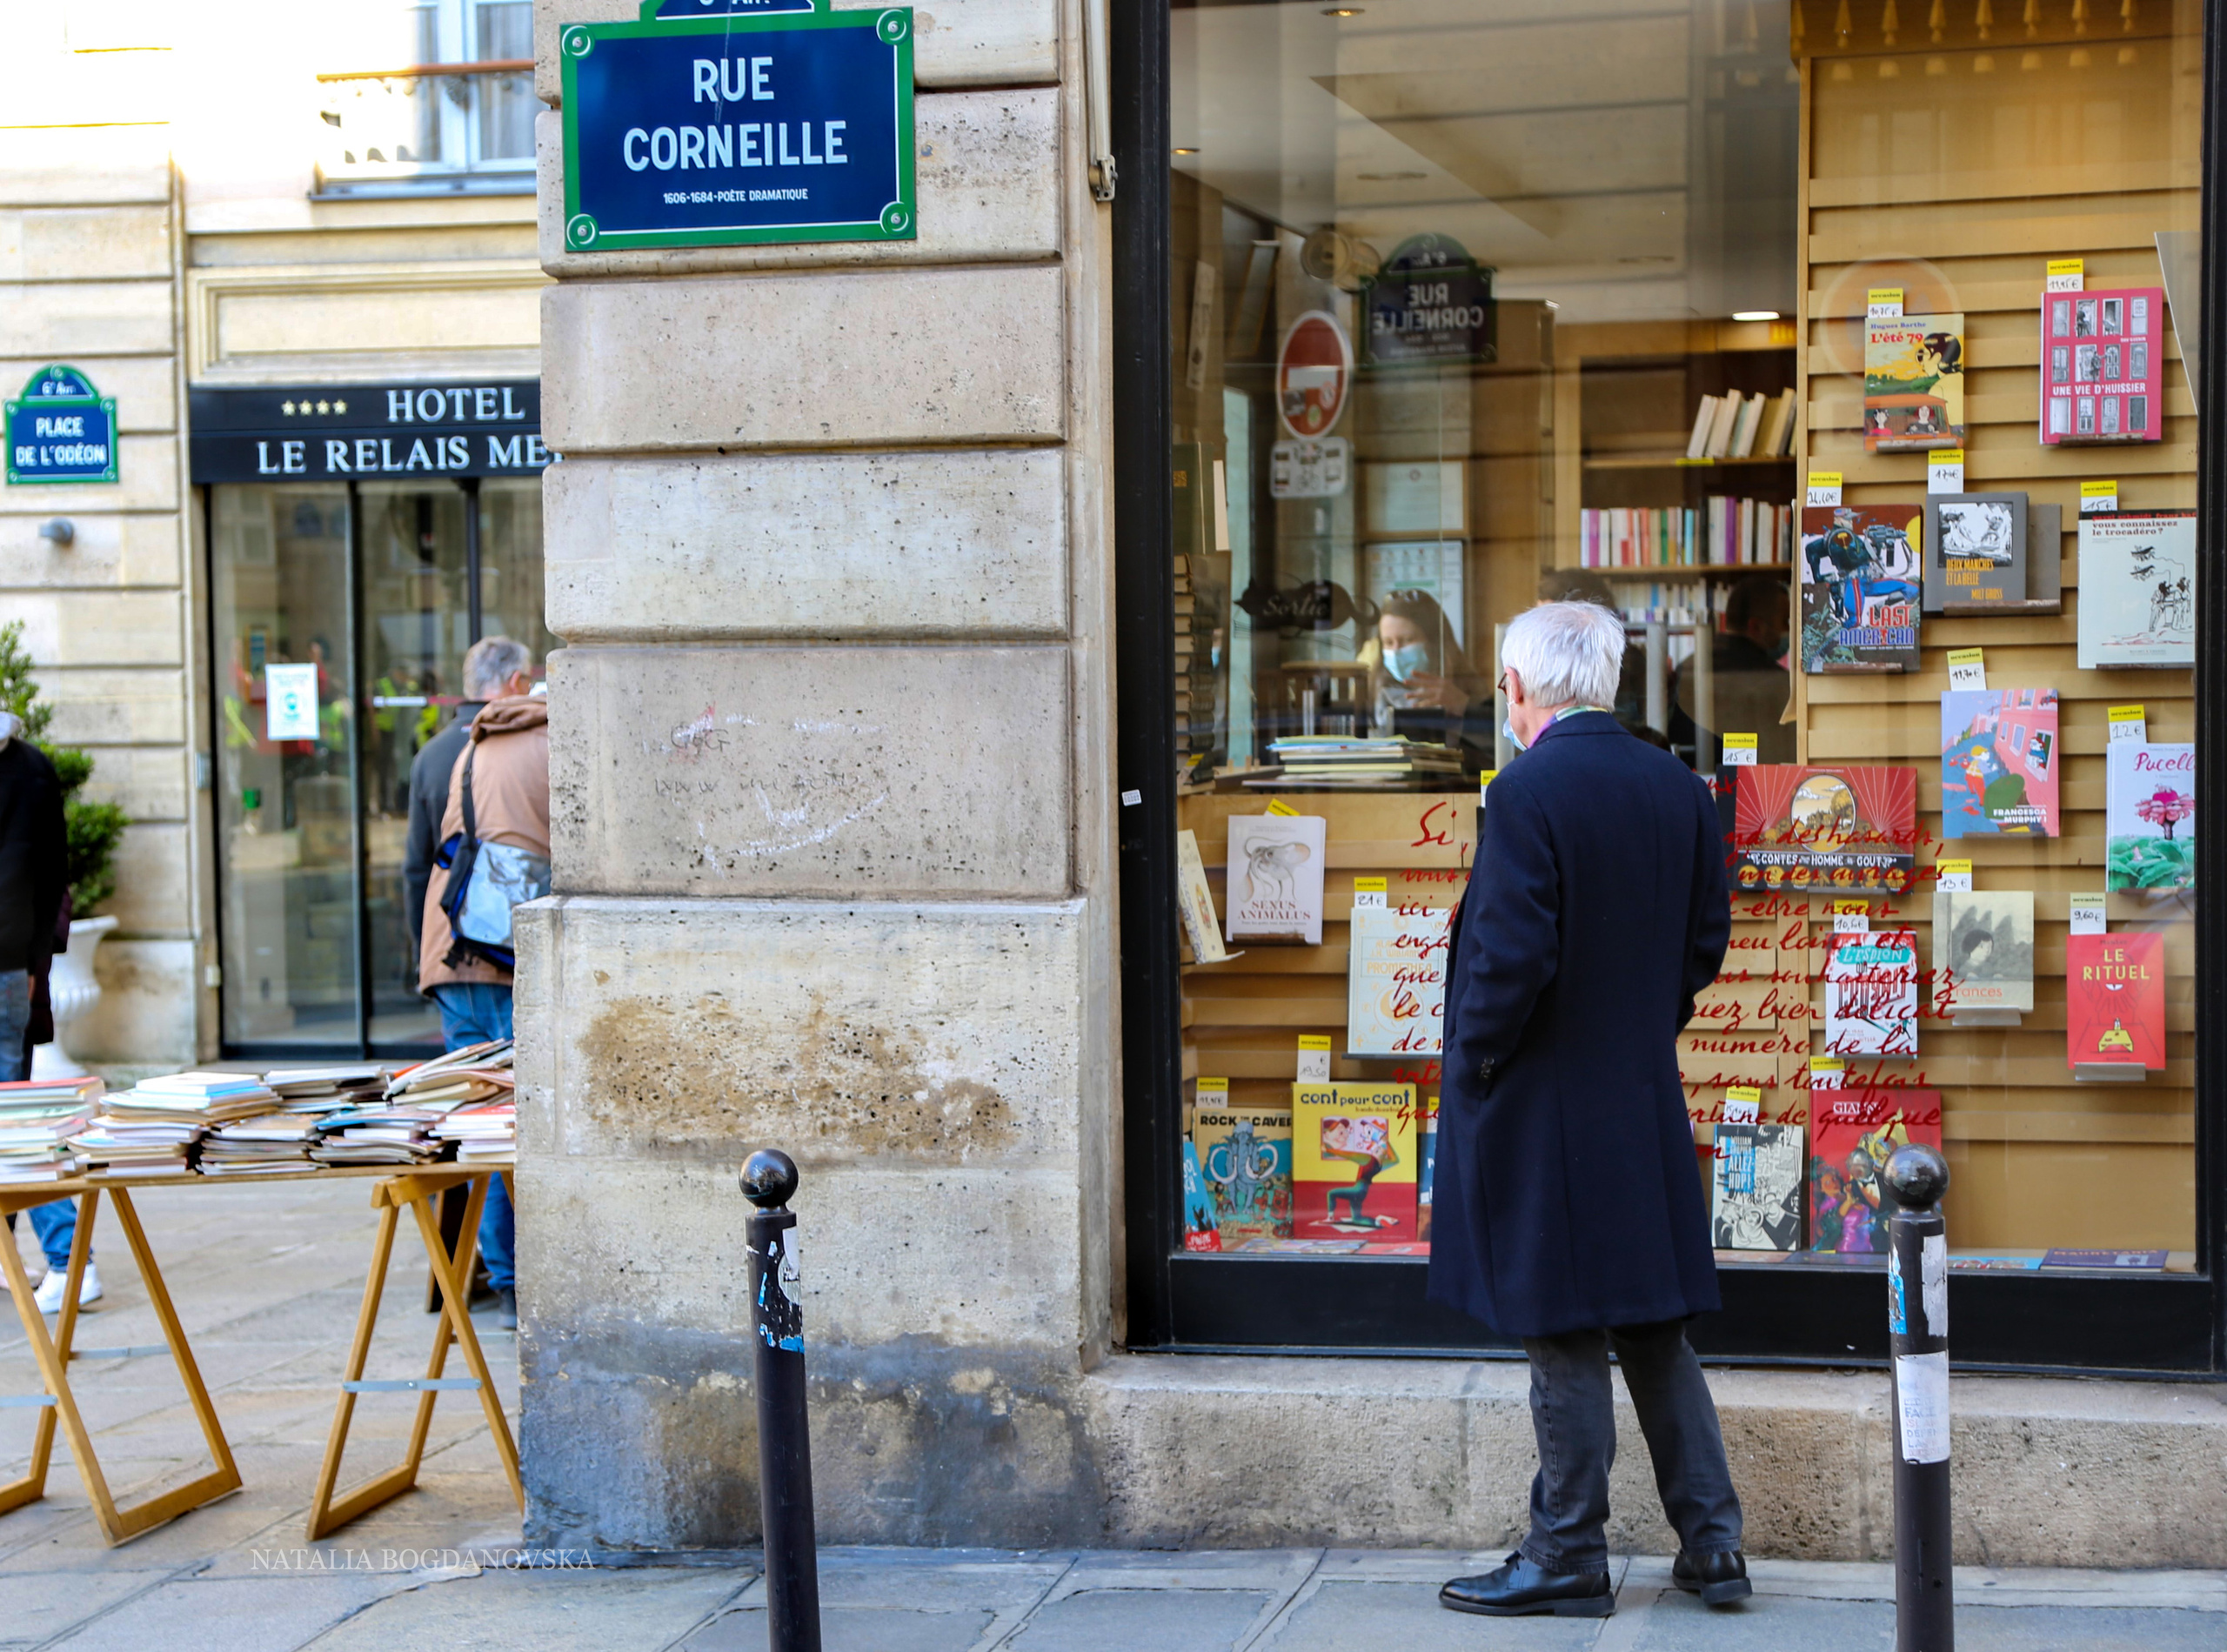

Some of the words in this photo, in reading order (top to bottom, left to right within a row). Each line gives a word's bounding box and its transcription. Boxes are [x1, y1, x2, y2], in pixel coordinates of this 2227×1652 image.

[693, 56, 774, 104] RUE
[624, 120, 848, 172] CORNEILLE
[749, 188, 809, 202] DRAMATIQUE
[1870, 331, 1903, 344] L'été
[1906, 333, 1923, 344] 79
[2053, 385, 2071, 396] UNE
[2075, 385, 2090, 395] VIE
[2094, 383, 2146, 395] D'HUISSIER
[387, 387, 525, 423] HOTEL
[36, 417, 85, 438] PLACE
[16, 445, 37, 467] DE
[40, 442, 107, 466] L'ODÉON
[257, 440, 307, 474] LE
[325, 436, 470, 472] RELAIS
[487, 432, 558, 469] ME
[1946, 558, 1963, 572] DEUX
[1964, 558, 1995, 572] MANCHES
[1869, 605, 1913, 626] LAST
[1839, 627, 1915, 645] AMERICAN
[2112, 724, 2132, 739] 12
[2133, 752, 2196, 772] Pucell
[1993, 807, 2047, 817] FRANCESCA
[2004, 815, 2042, 824] MURPHY
[1811, 853, 1843, 866] HOMME
[1252, 900, 1296, 910] SEXUS
[1238, 911, 1311, 920] ANIMALUS
[2103, 947, 2124, 963] LE
[2083, 965, 2150, 980] RITUEL
[1949, 987, 2003, 998] rances
[1340, 1096, 1369, 1107] pour
[1200, 1115, 1238, 1127] ROCK
